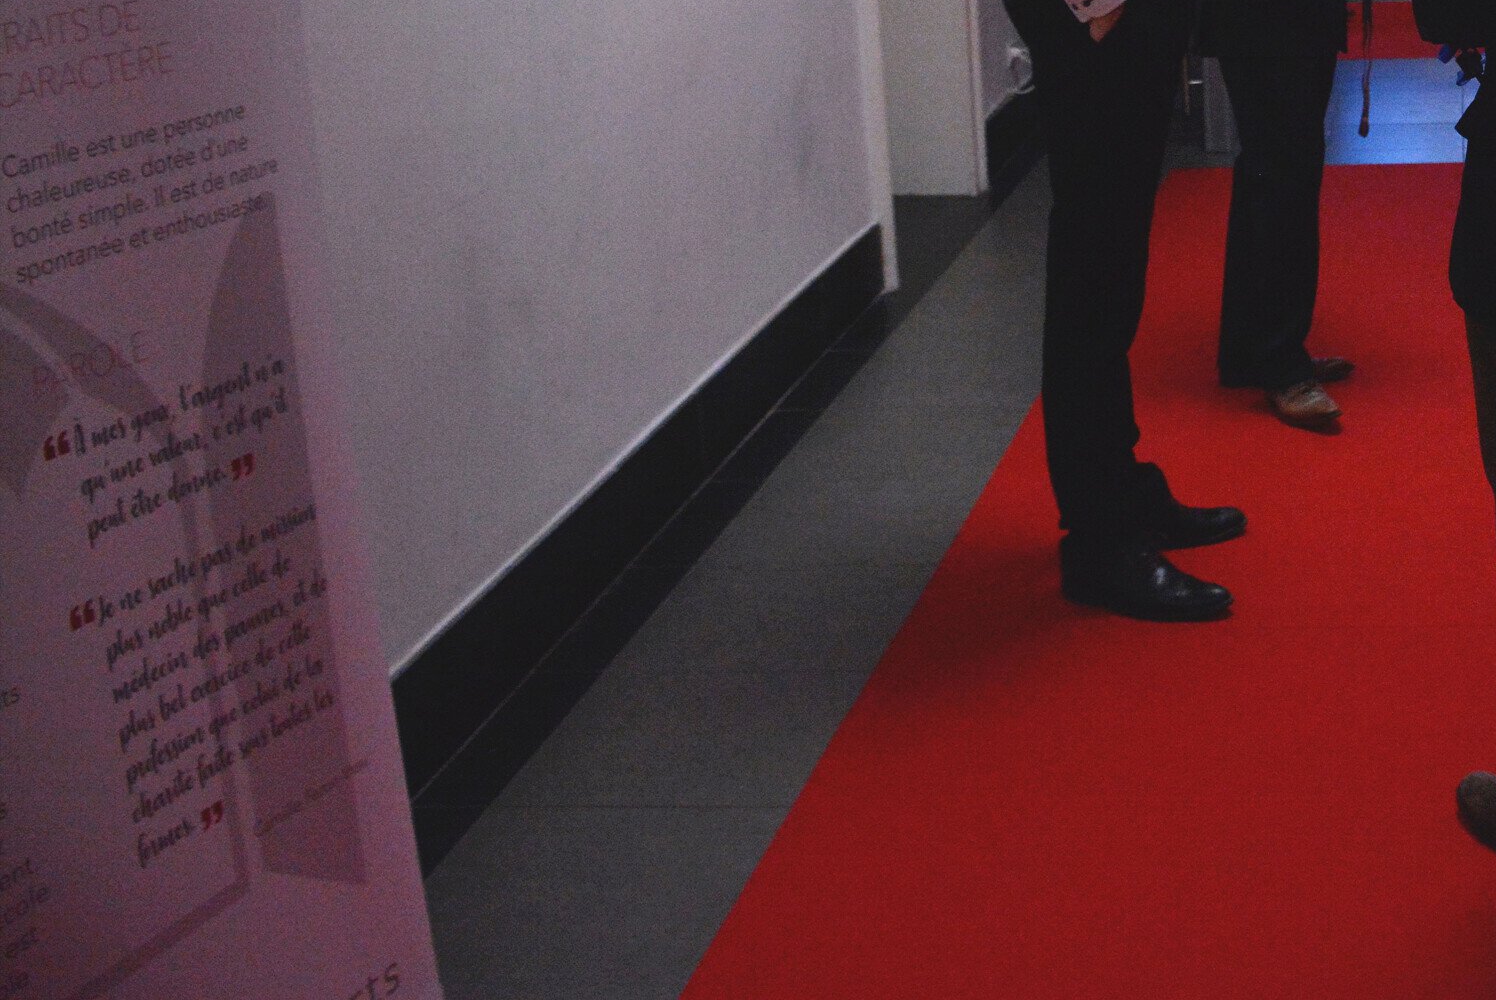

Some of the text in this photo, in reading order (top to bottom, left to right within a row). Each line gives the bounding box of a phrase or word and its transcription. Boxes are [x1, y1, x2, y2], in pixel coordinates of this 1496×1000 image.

[98, 0, 141, 37] DE
[2, 105, 245, 178] Camille est une personne
[170, 181, 197, 203] est
[202, 171, 224, 194] de
[129, 228, 150, 248] et
